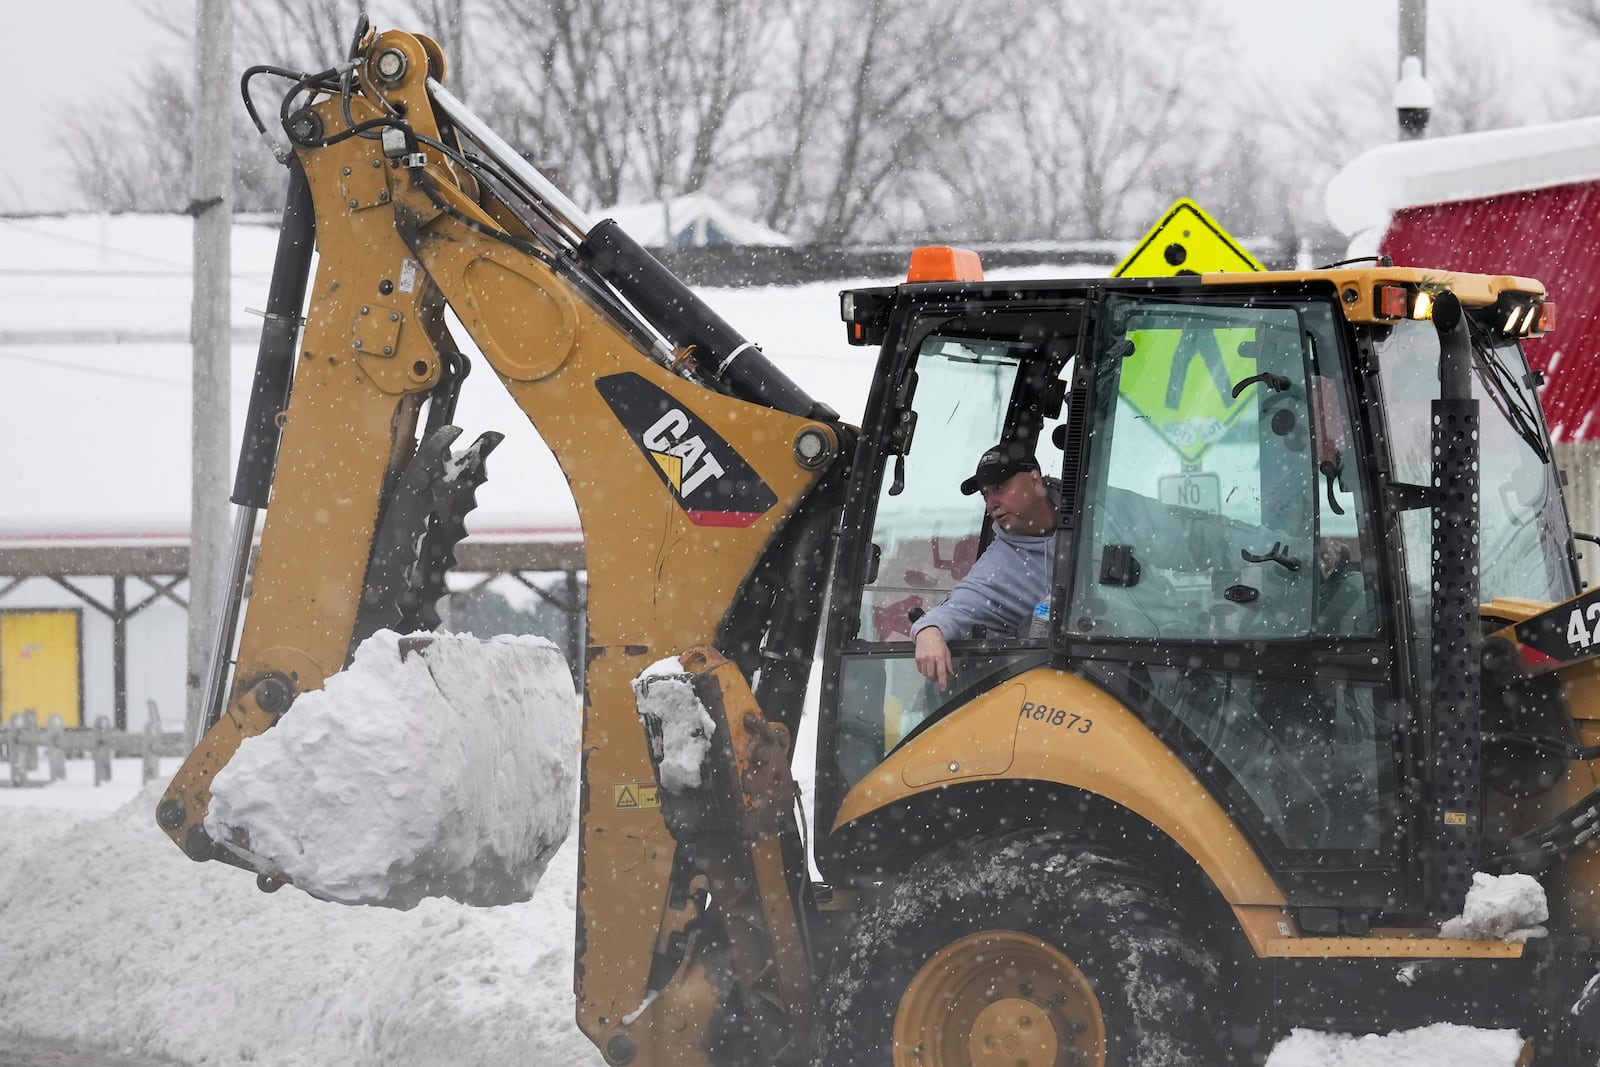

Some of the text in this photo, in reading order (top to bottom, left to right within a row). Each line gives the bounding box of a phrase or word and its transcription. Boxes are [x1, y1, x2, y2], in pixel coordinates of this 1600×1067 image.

[642, 408, 725, 499] CAT
[1178, 483, 1200, 505] NO
[1020, 701, 1093, 734] R81873
